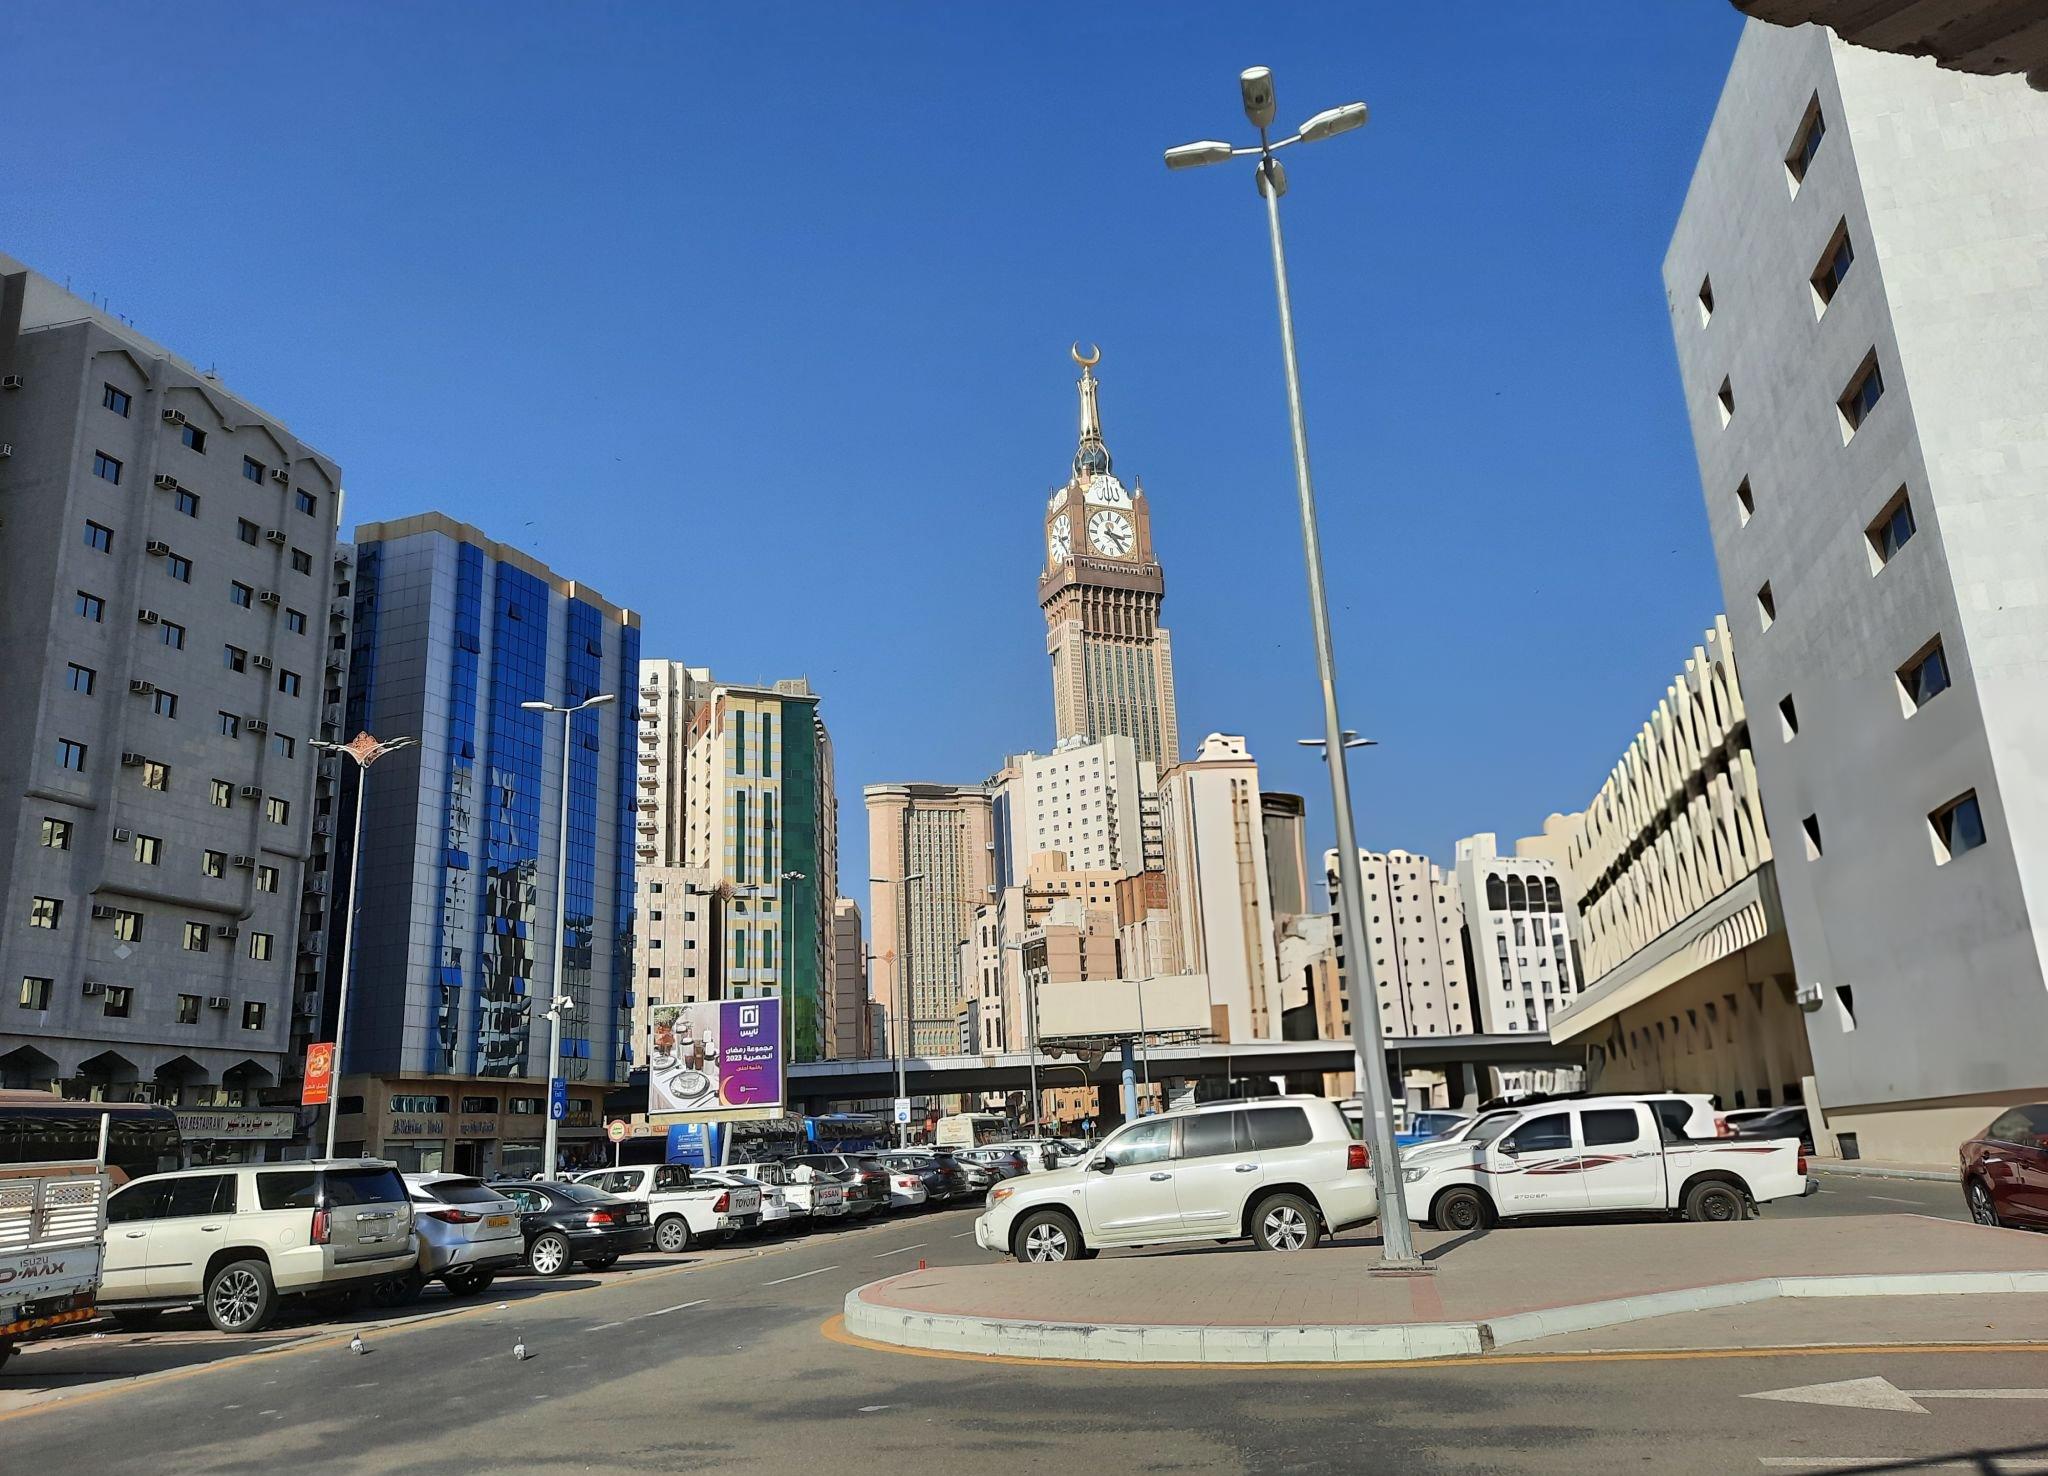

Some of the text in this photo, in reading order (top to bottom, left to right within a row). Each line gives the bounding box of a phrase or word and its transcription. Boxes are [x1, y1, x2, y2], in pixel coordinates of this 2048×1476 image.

[819, 1190, 839, 1199] NISSAN
[735, 1197, 756, 1208] TOYOTA
[20, 1256, 49, 1267] ISUZU
